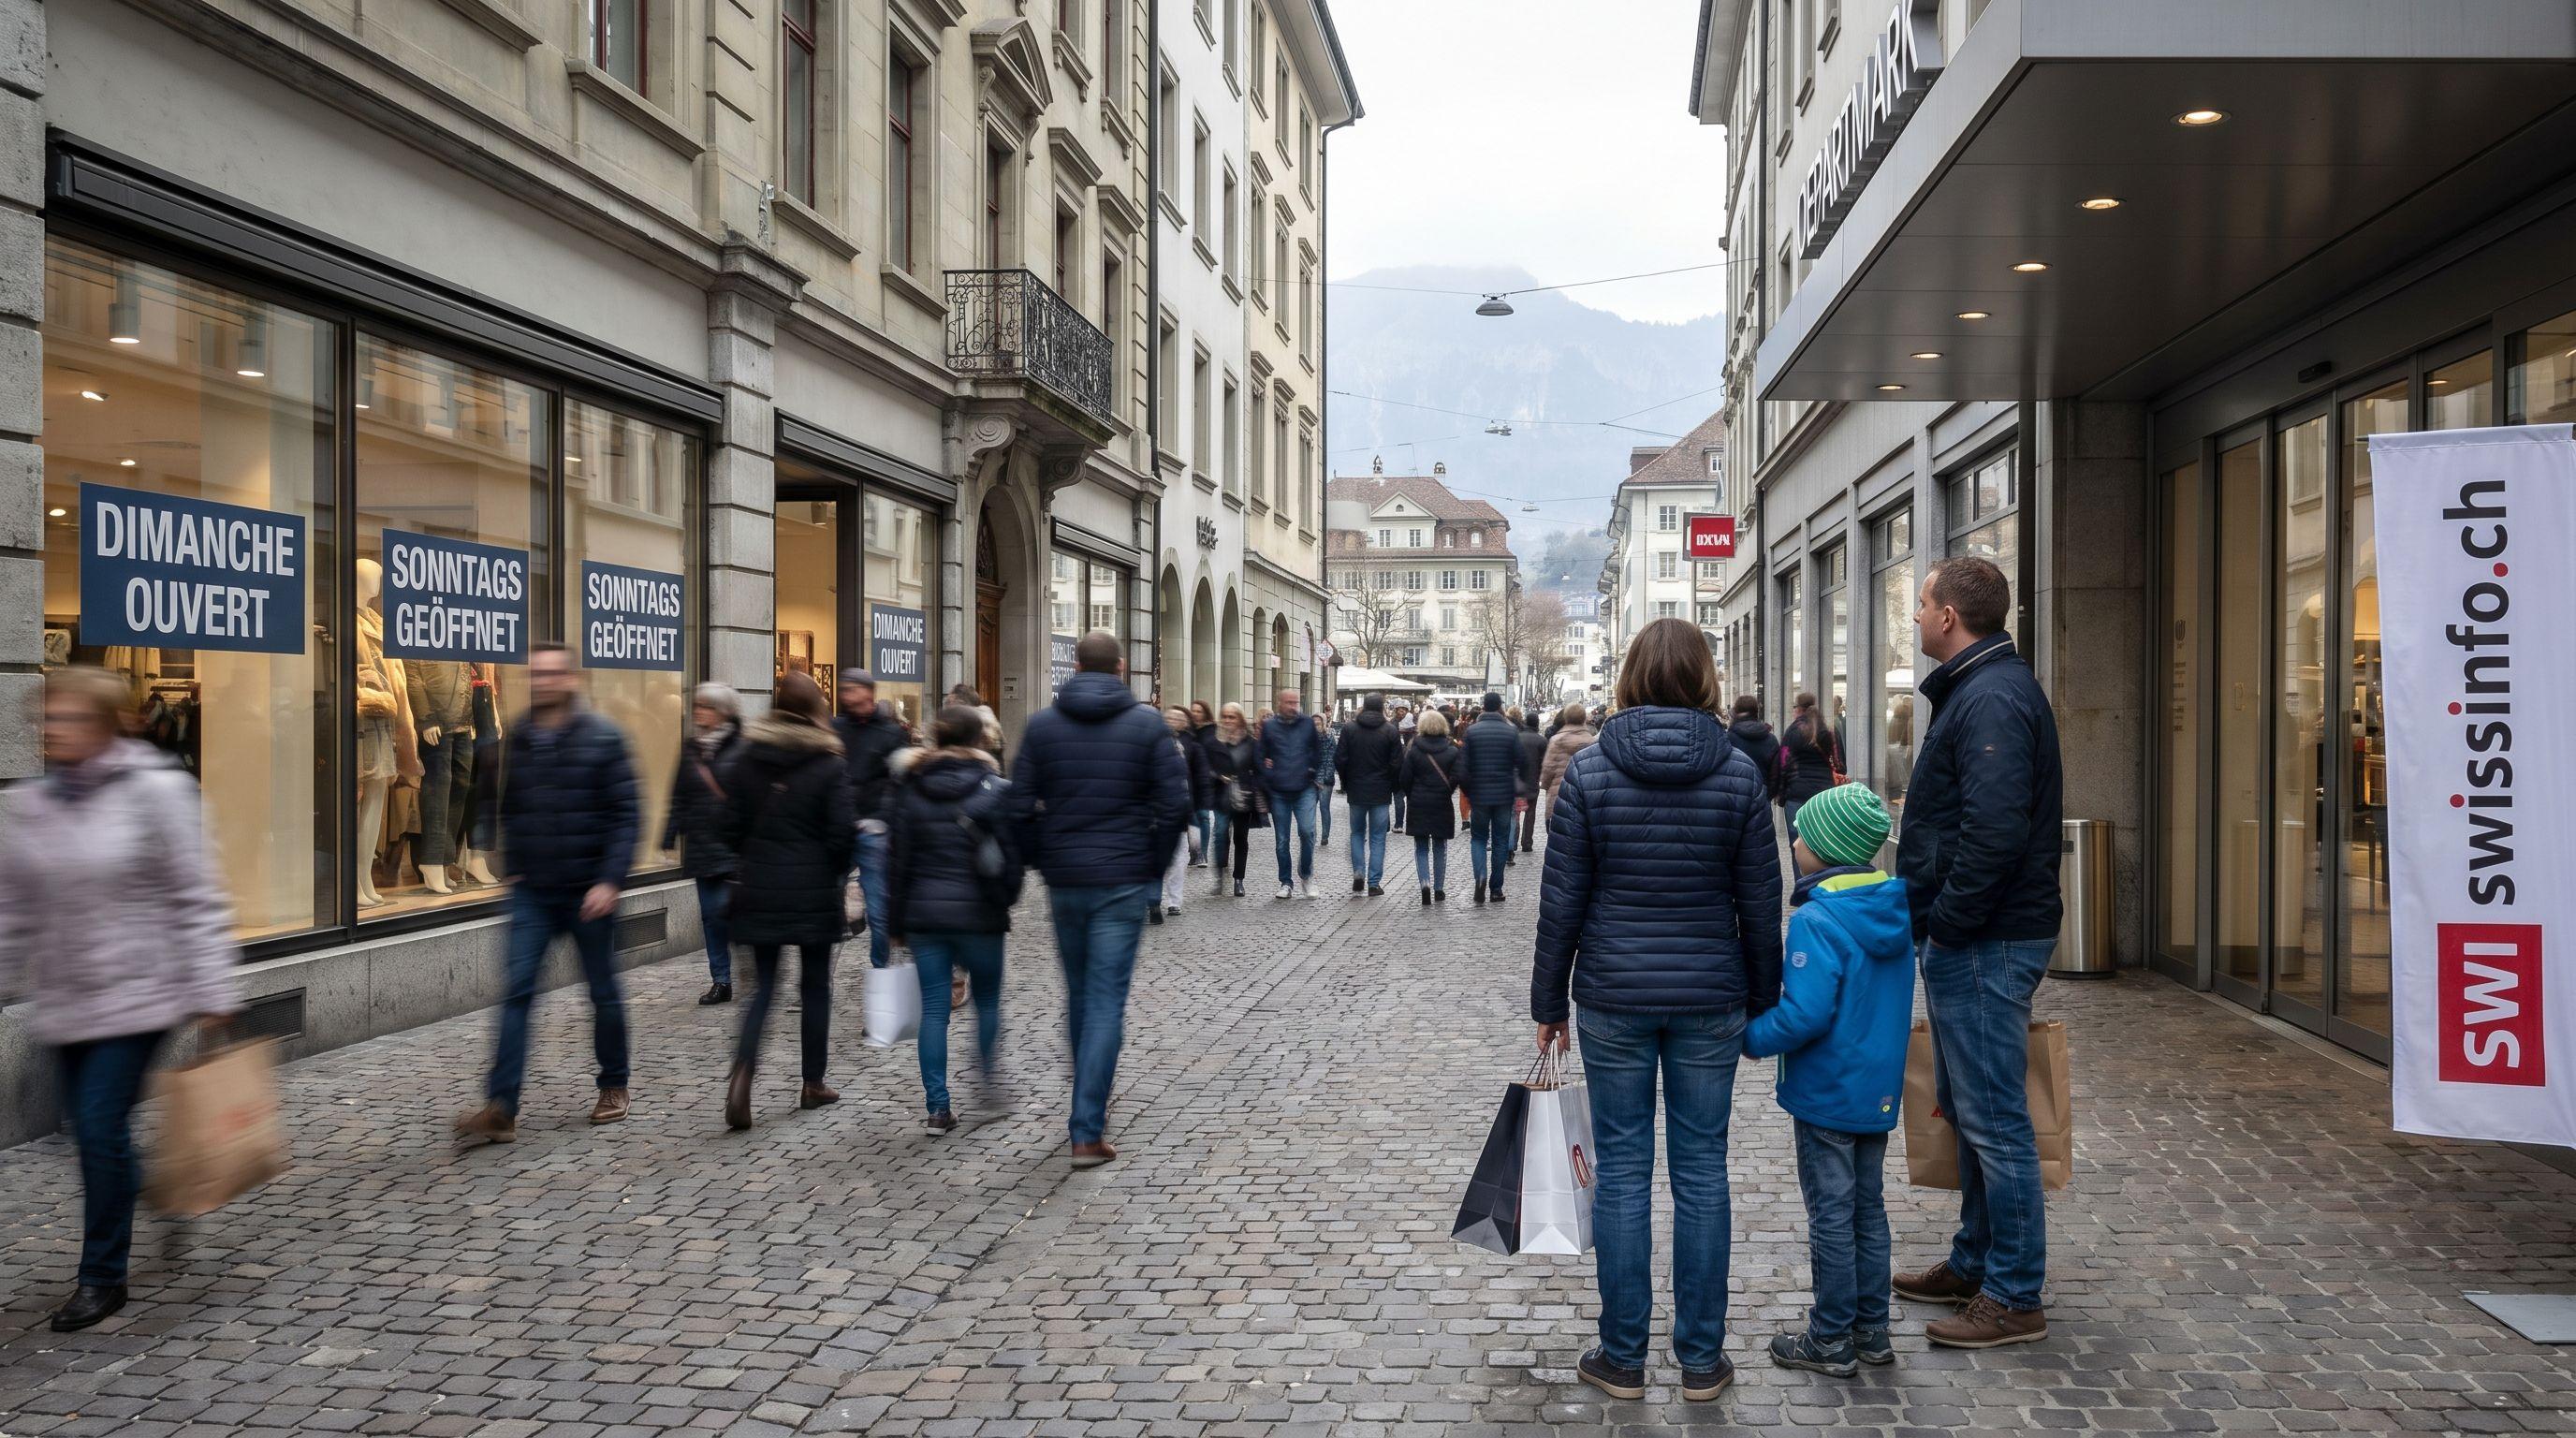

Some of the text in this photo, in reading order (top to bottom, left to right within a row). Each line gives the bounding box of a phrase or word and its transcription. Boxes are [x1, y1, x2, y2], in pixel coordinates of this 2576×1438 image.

[96, 501, 295, 577] DIMANCHE
[391, 543, 522, 601] SONNTAGS
[588, 572, 681, 618] SONNTAGS
[125, 577, 270, 638] OUVERT
[396, 595, 520, 653] GEÖFFNET
[873, 612, 924, 644] DIMANCHE
[590, 614, 678, 662] GEÖFFNET
[881, 647, 917, 675] OUVERT
[2442, 479, 2521, 1068] SWI swissinfo.ch
